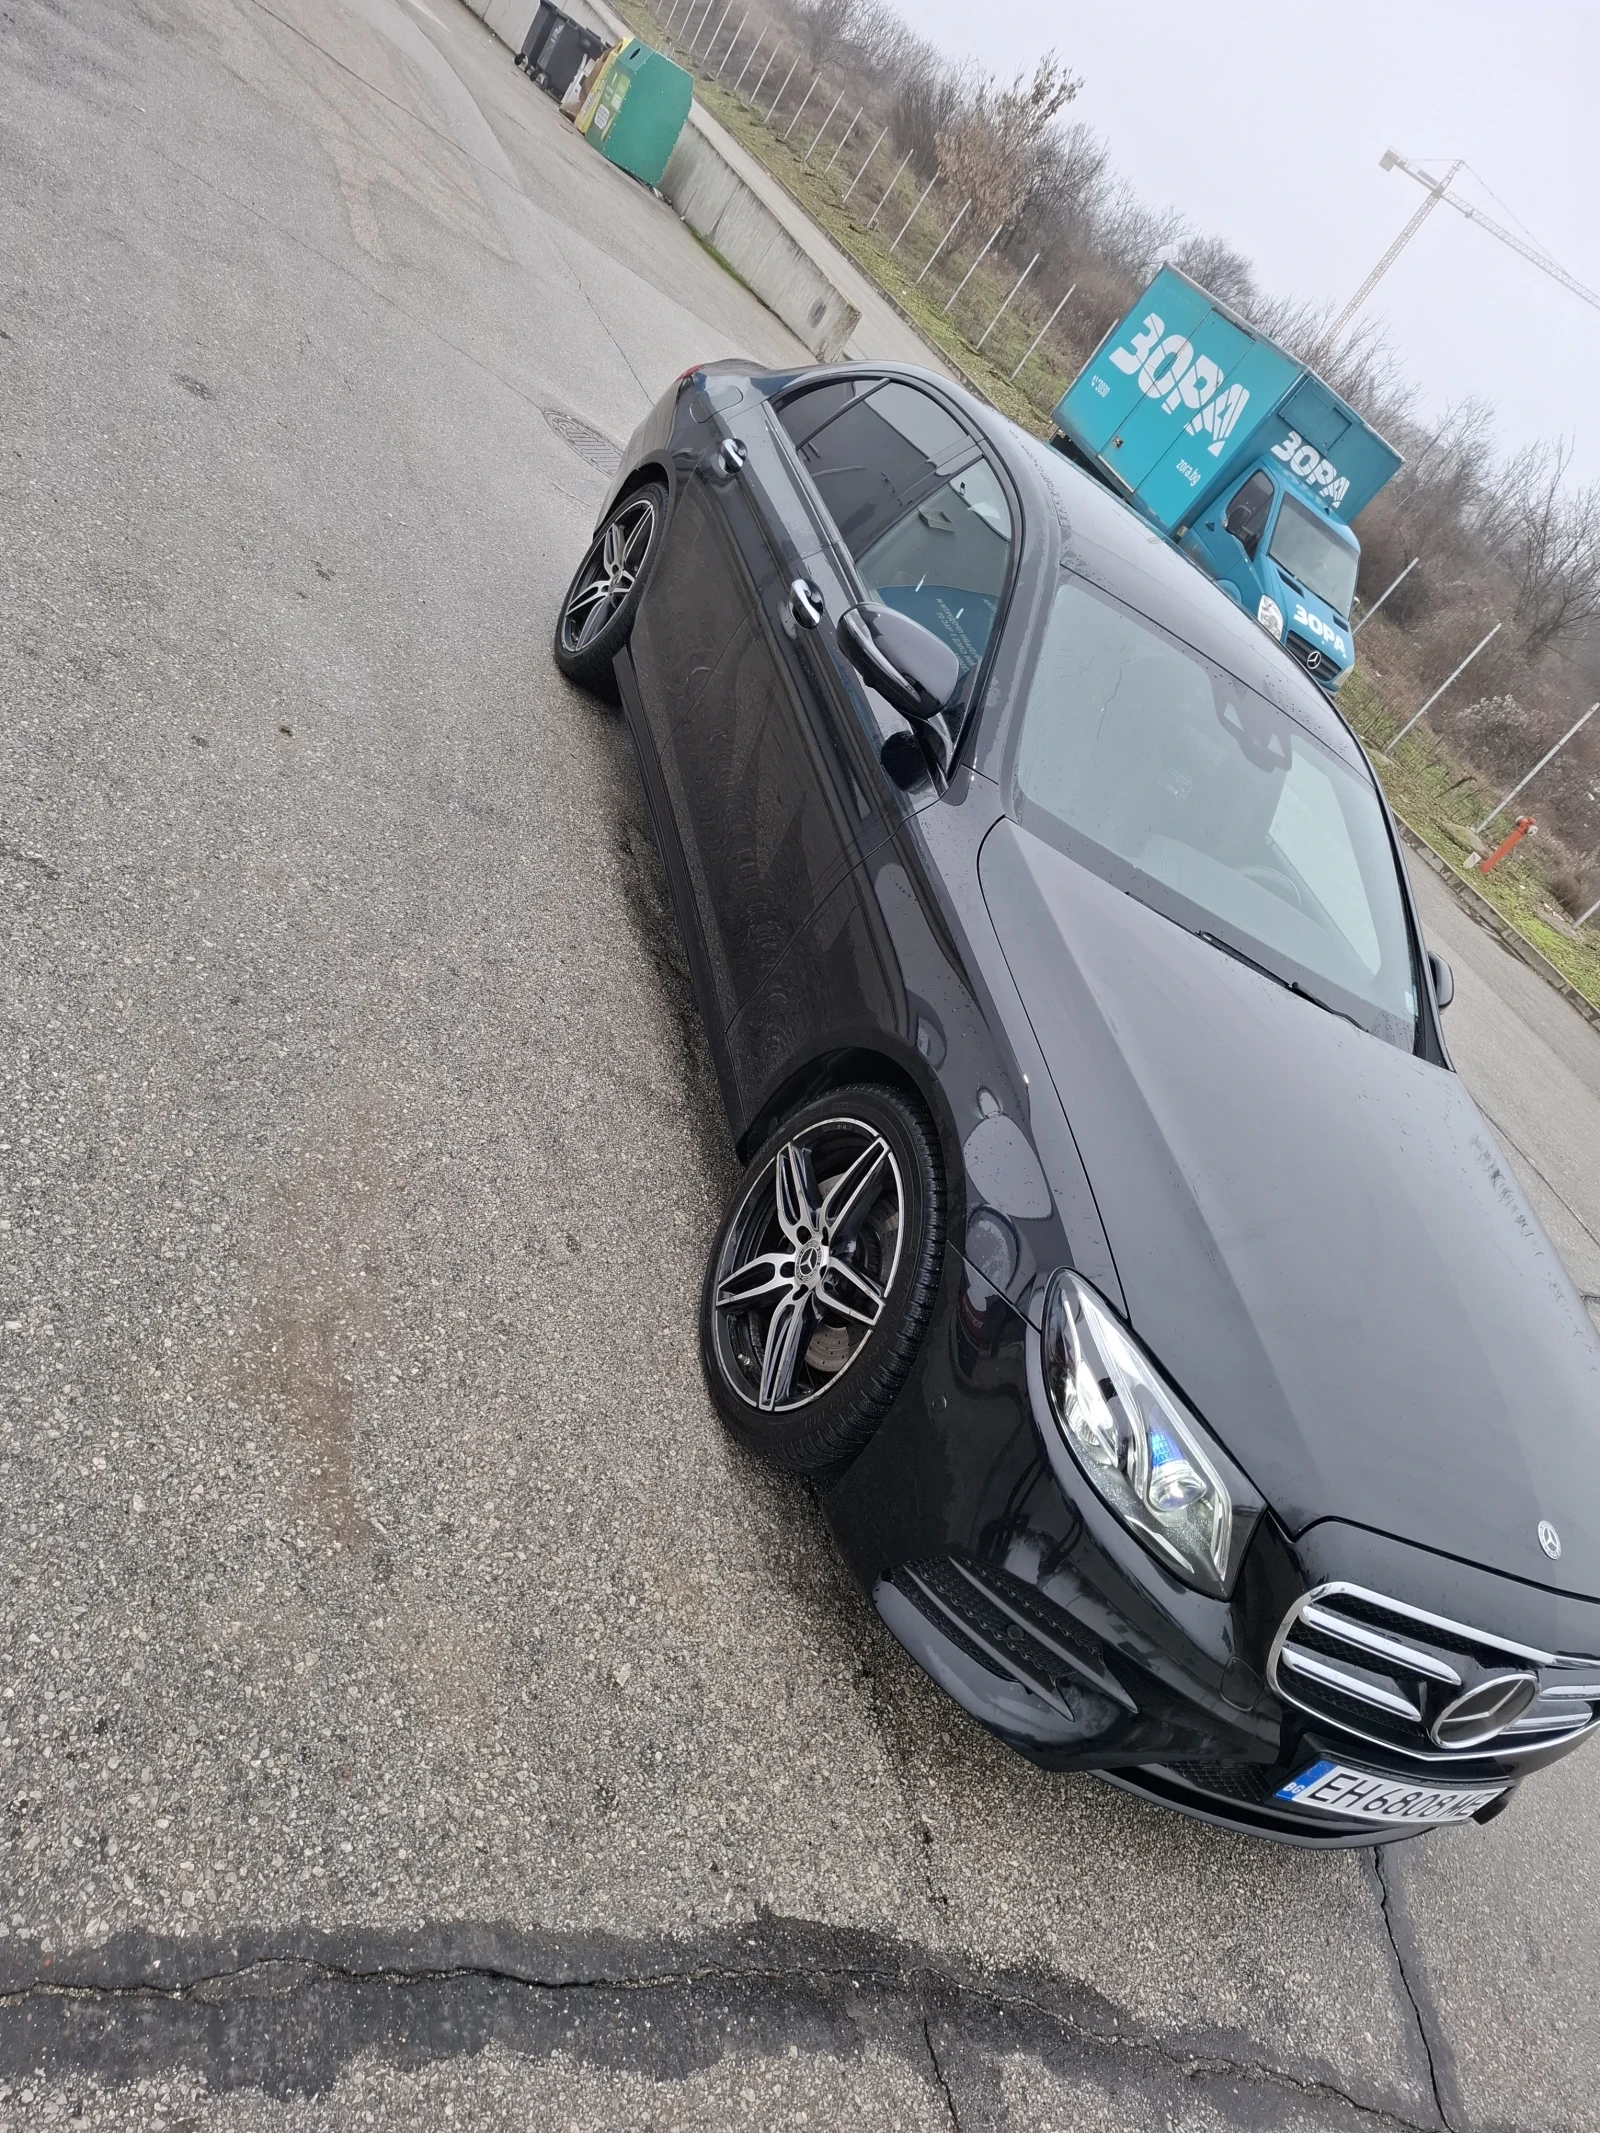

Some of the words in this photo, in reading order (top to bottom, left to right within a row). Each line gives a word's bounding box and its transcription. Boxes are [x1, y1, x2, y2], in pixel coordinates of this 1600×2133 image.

[1109, 312, 1250, 457] ЗОРА
[1176, 459, 1201, 487] zora.bg
[1270, 430, 1350, 508] ЗОРА
[1293, 603, 1347, 659] ЗОРА
[1282, 1782, 1305, 1795] BG
